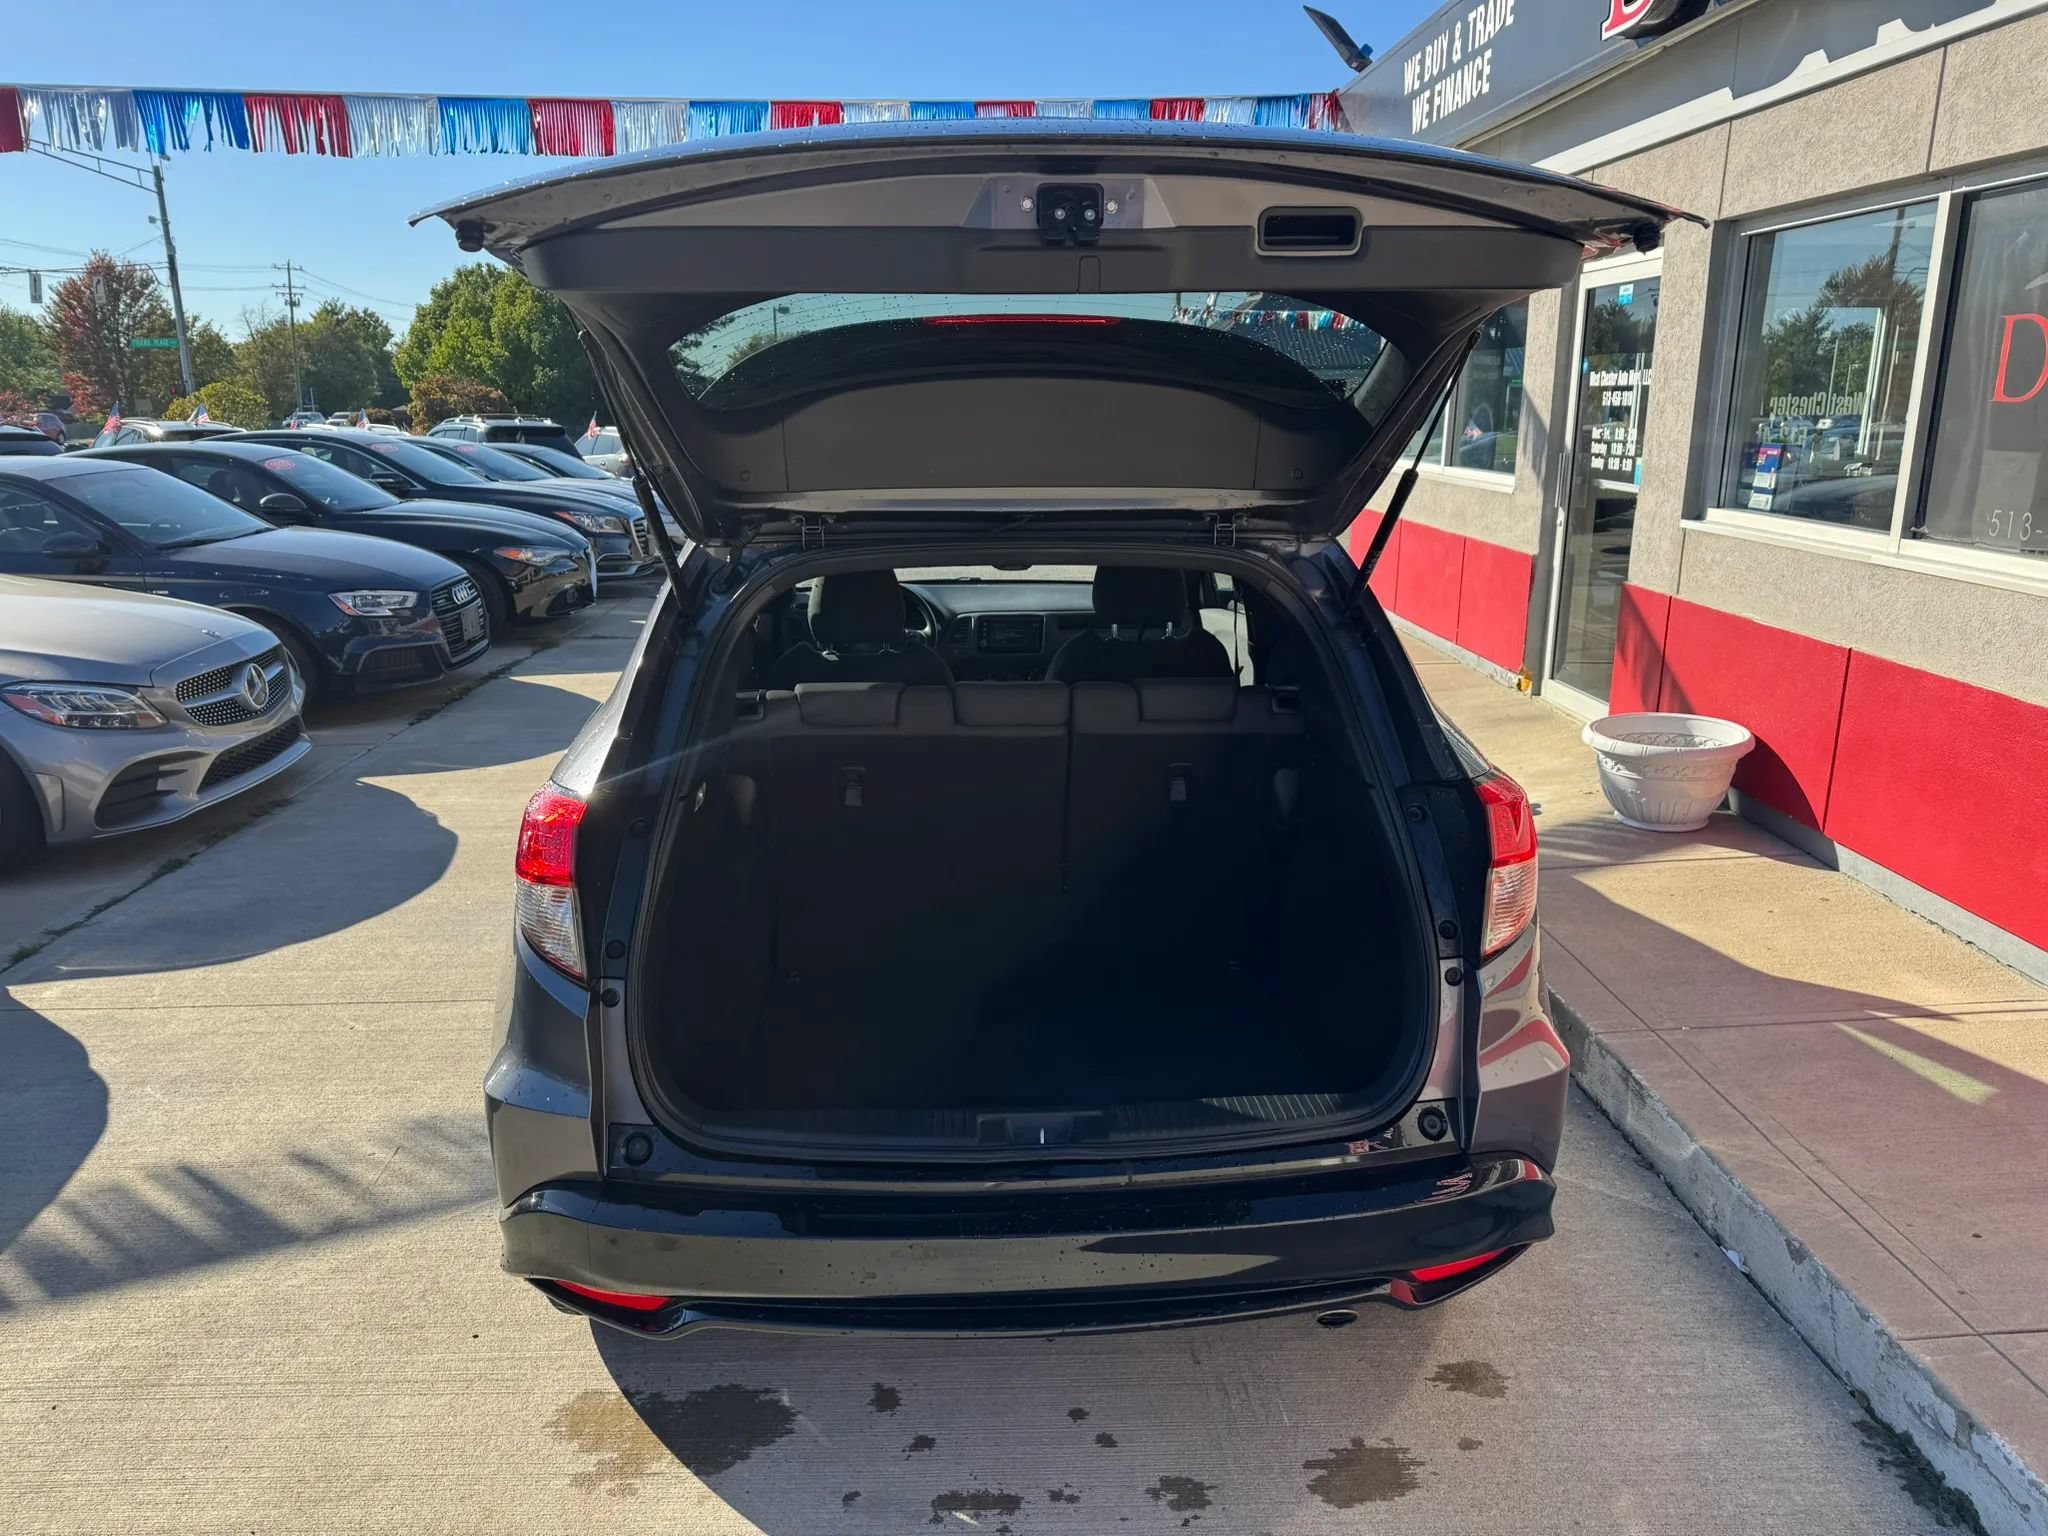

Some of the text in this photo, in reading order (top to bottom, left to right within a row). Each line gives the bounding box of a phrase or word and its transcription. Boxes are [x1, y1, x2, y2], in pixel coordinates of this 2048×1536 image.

[1403, 0, 1515, 96] WE BUY & TRADE
[1411, 48, 1493, 135] WE FINANCE
[1590, 371, 1601, 387] West
[1600, 370, 1618, 387] Chester
[1617, 369, 1629, 386] Auto
[1989, 509, 2048, 541] 513-
